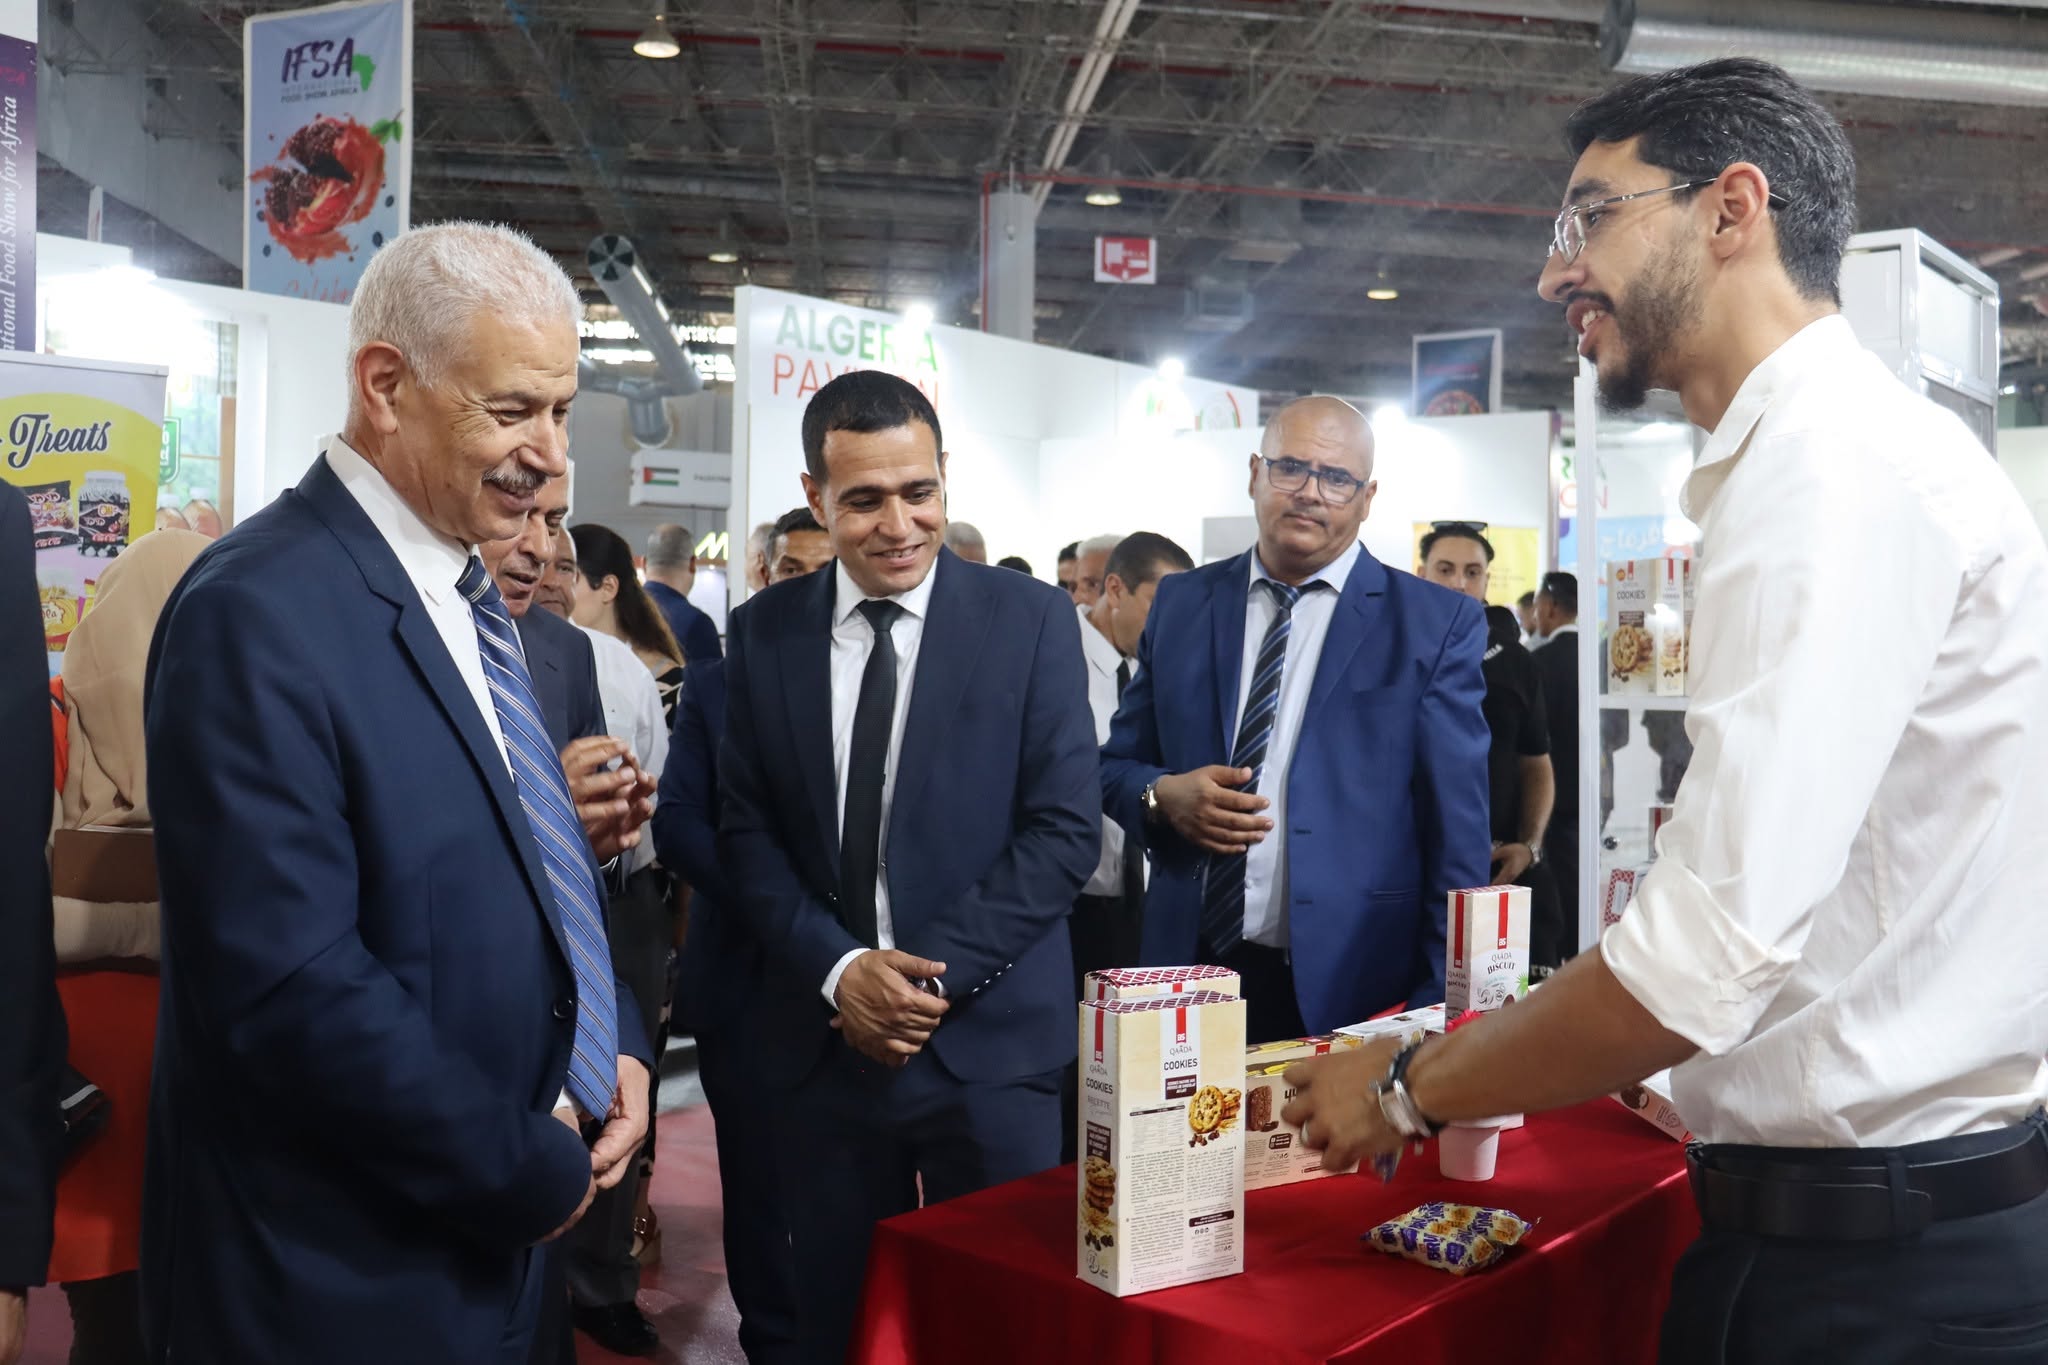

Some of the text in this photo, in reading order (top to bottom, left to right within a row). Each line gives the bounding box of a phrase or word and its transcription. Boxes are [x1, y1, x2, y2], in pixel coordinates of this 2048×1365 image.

[281, 37, 355, 83] IFSA
[0, 96, 22, 155] Africa
[0, 158, 22, 189] for
[0, 187, 16, 238] Show
[0, 242, 16, 287] Food
[776, 303, 938, 373] ALGERA
[7, 414, 112, 469] Treats
[1487, 962, 1516, 975] BISCUIT
[1085, 1077, 1114, 1095] COOKIES
[1163, 1057, 1199, 1071] COOKIES
